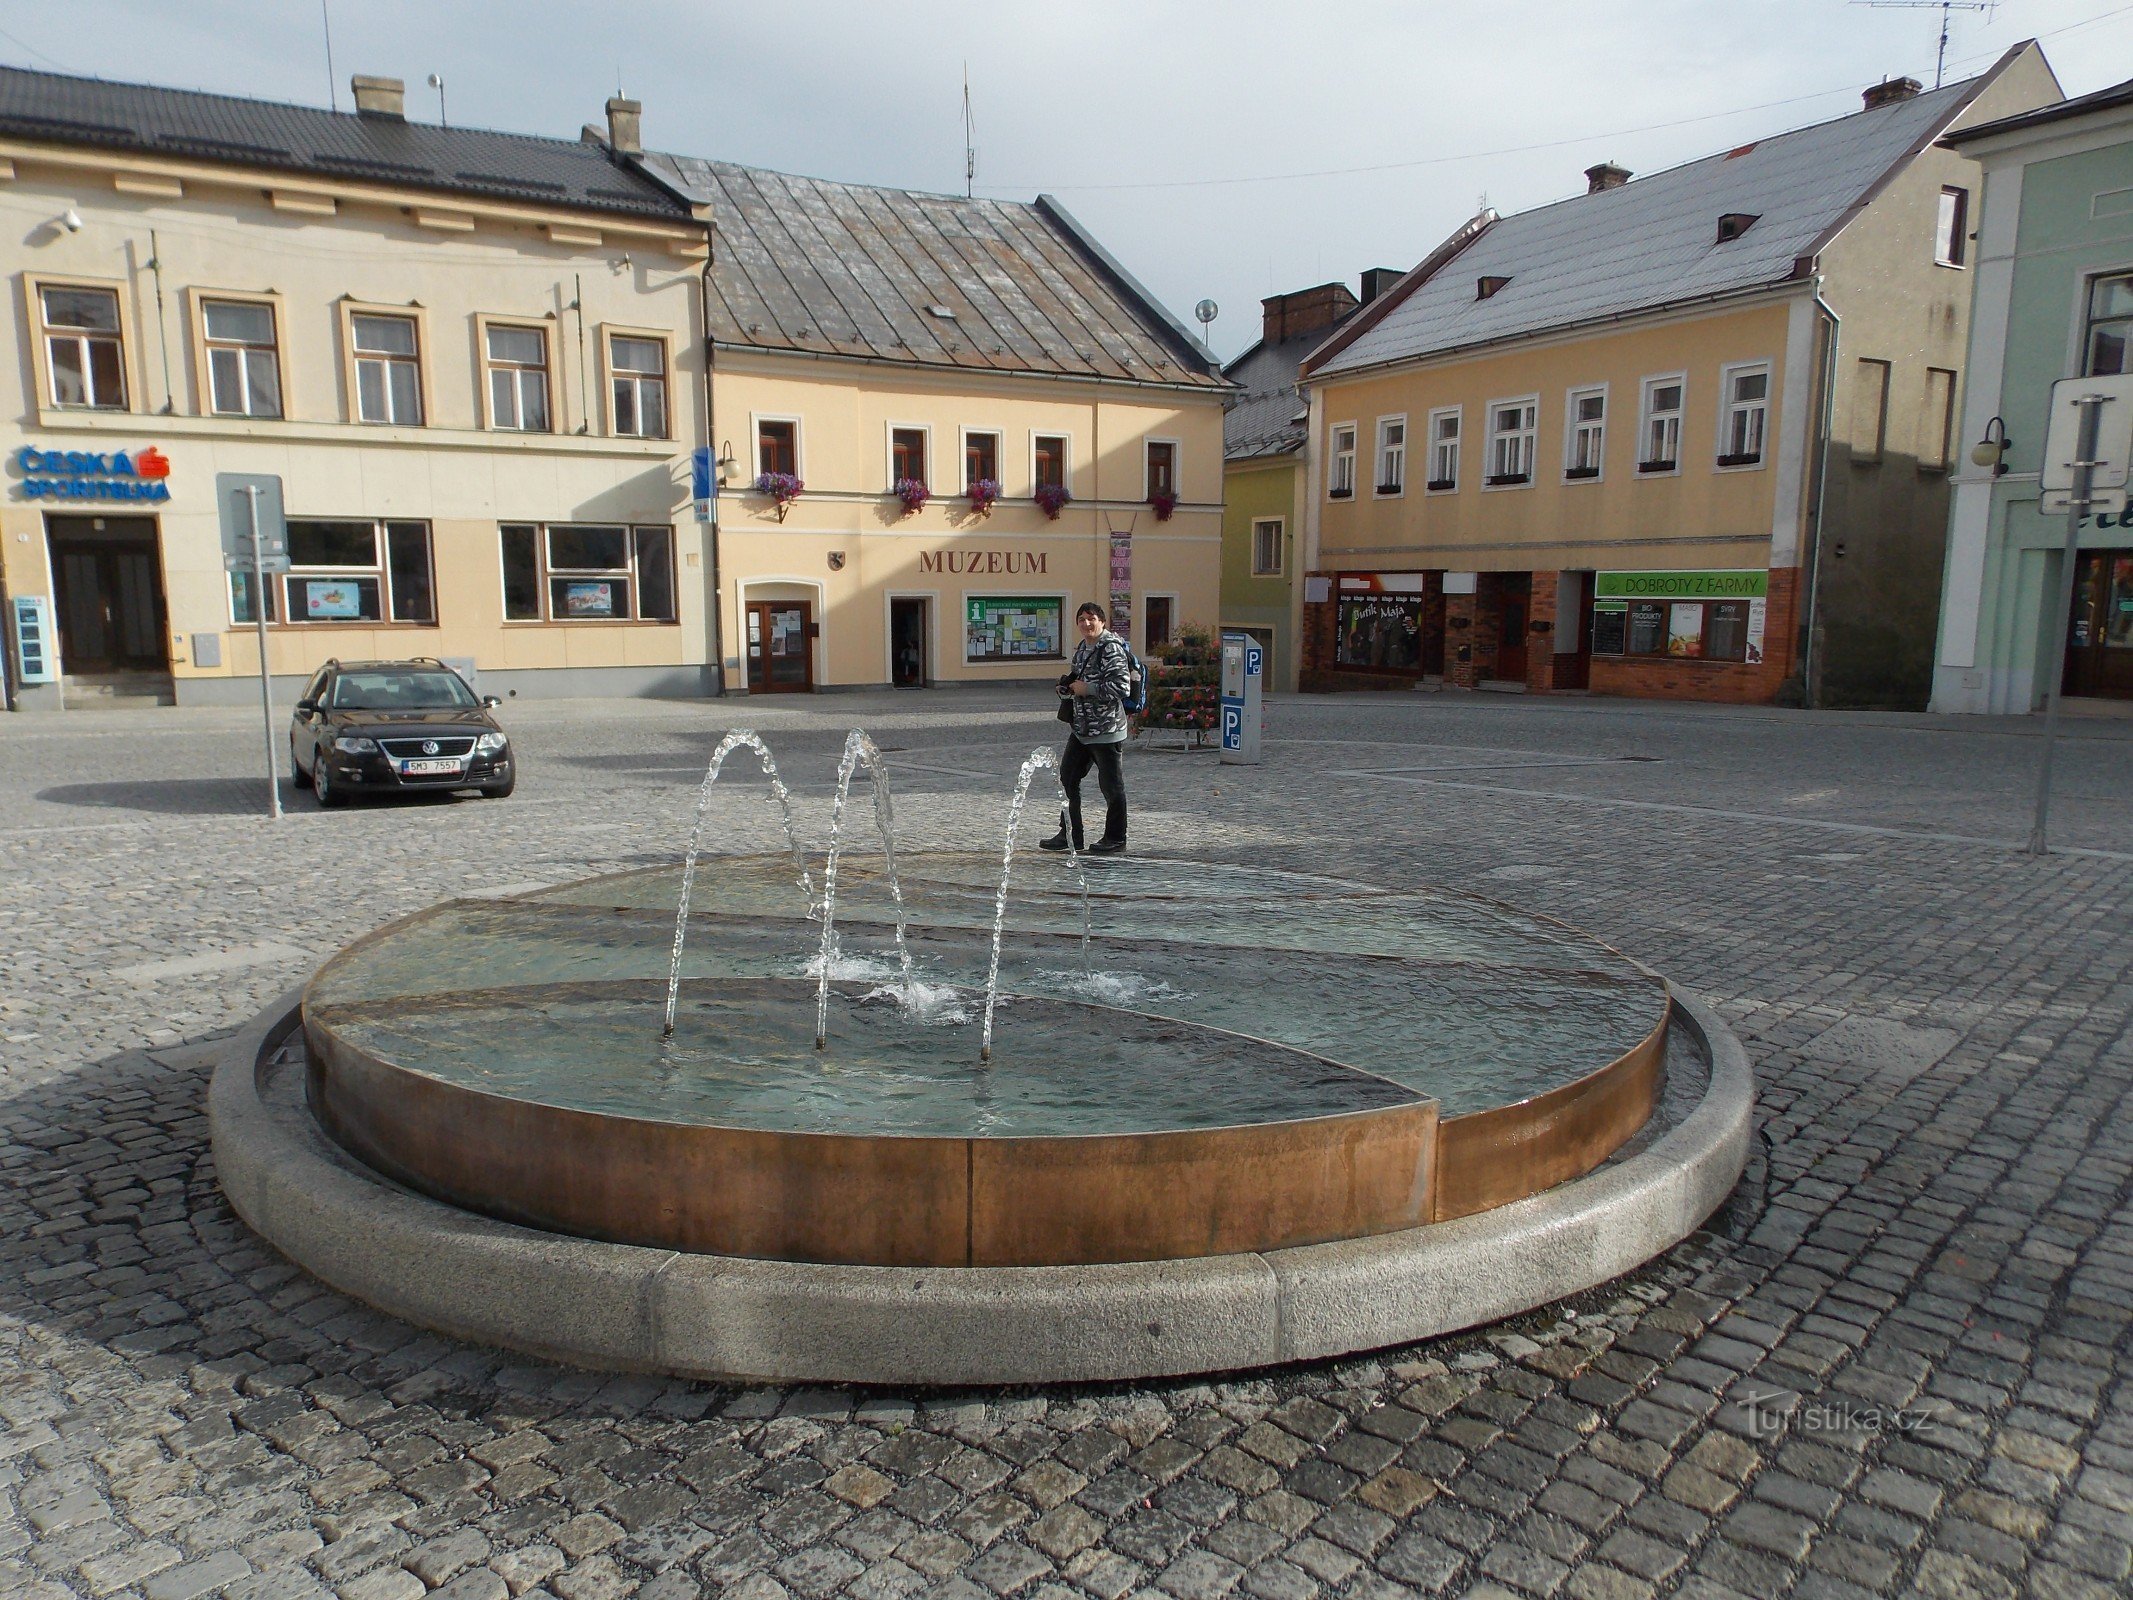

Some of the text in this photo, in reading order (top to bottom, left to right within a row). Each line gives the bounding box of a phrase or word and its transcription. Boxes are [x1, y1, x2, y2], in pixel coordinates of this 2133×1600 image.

[19, 445, 136, 476] ČESKÁ
[919, 550, 1048, 574] MUZEUM
[1625, 578, 1759, 593] DOBROTY Z FARMY
[1380, 604, 1405, 618] Maja
[1631, 611, 1662, 620] PRODUKTY
[1249, 651, 1259, 668] P
[1226, 711, 1238, 737] P
[411, 761, 456, 770] 5M3 7557
